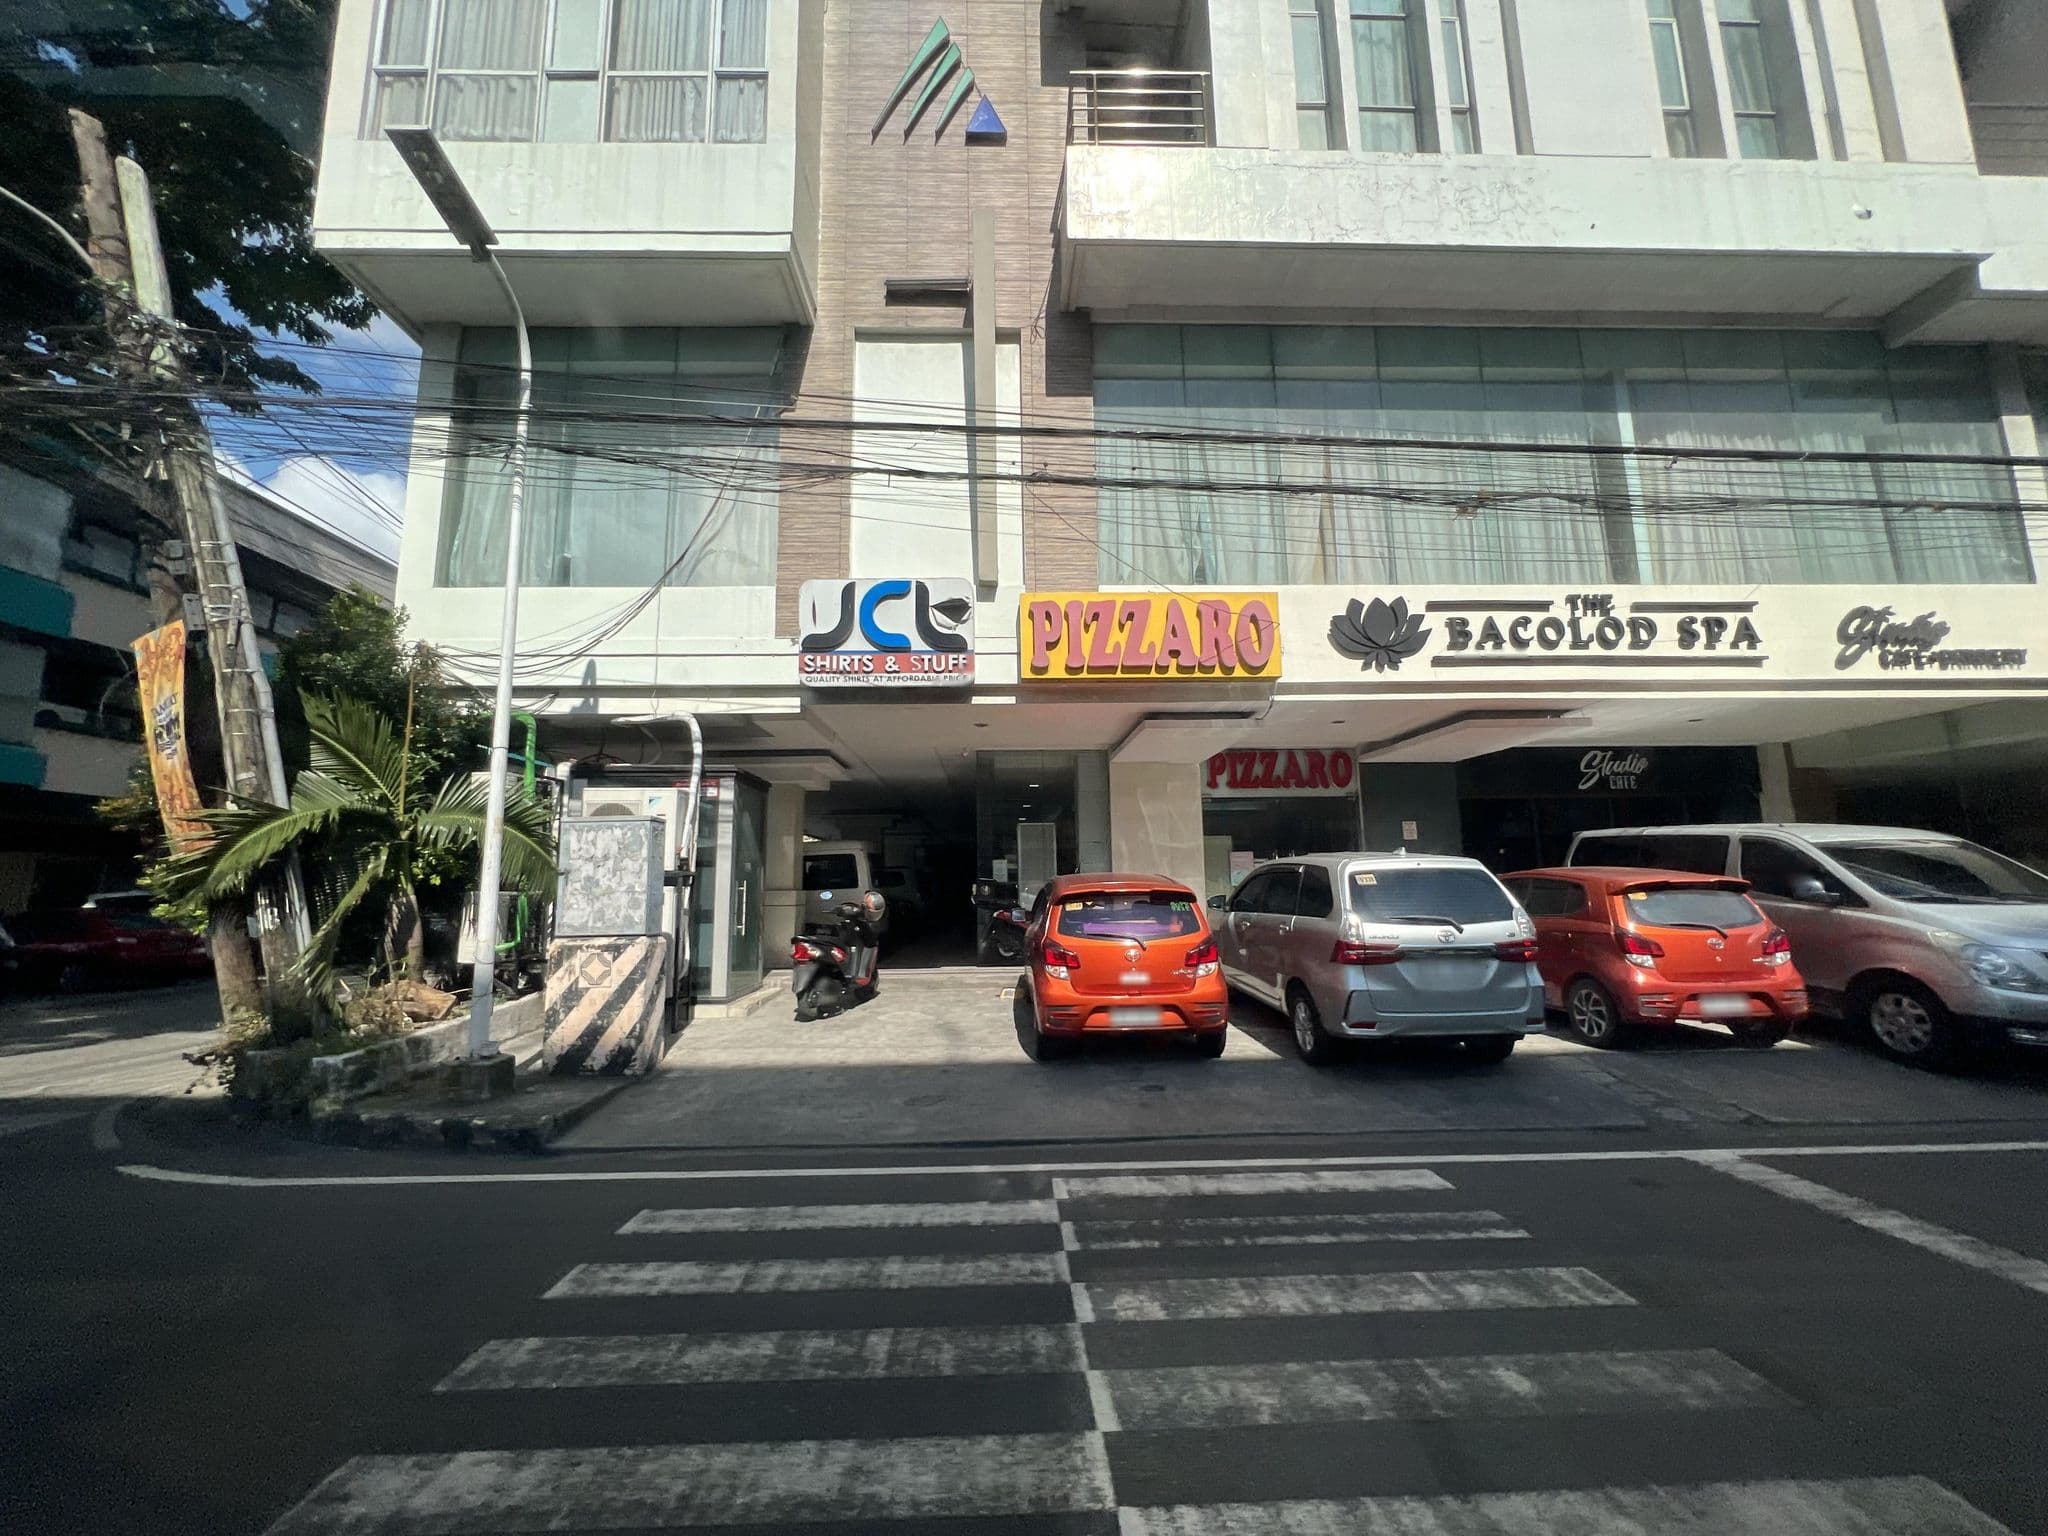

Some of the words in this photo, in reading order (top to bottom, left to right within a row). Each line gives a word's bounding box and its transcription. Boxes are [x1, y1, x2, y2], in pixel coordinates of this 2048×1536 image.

[801, 580, 968, 652] JCL
[1565, 594, 1615, 617] THE
[1028, 599, 1275, 675] PIZZARO
[1445, 615, 1657, 650] BACOLOD
[1677, 616, 1763, 650] SPA
[804, 654, 874, 673] SHIRTS
[885, 655, 900, 673] &
[911, 654, 968, 673] STUFF
[805, 675, 840, 683] QUALITY
[873, 674, 884, 682] AT
[1207, 749, 1353, 789] PIZZARO
[1578, 750, 1648, 789] Studio
[1609, 775, 1638, 789] CAFE
